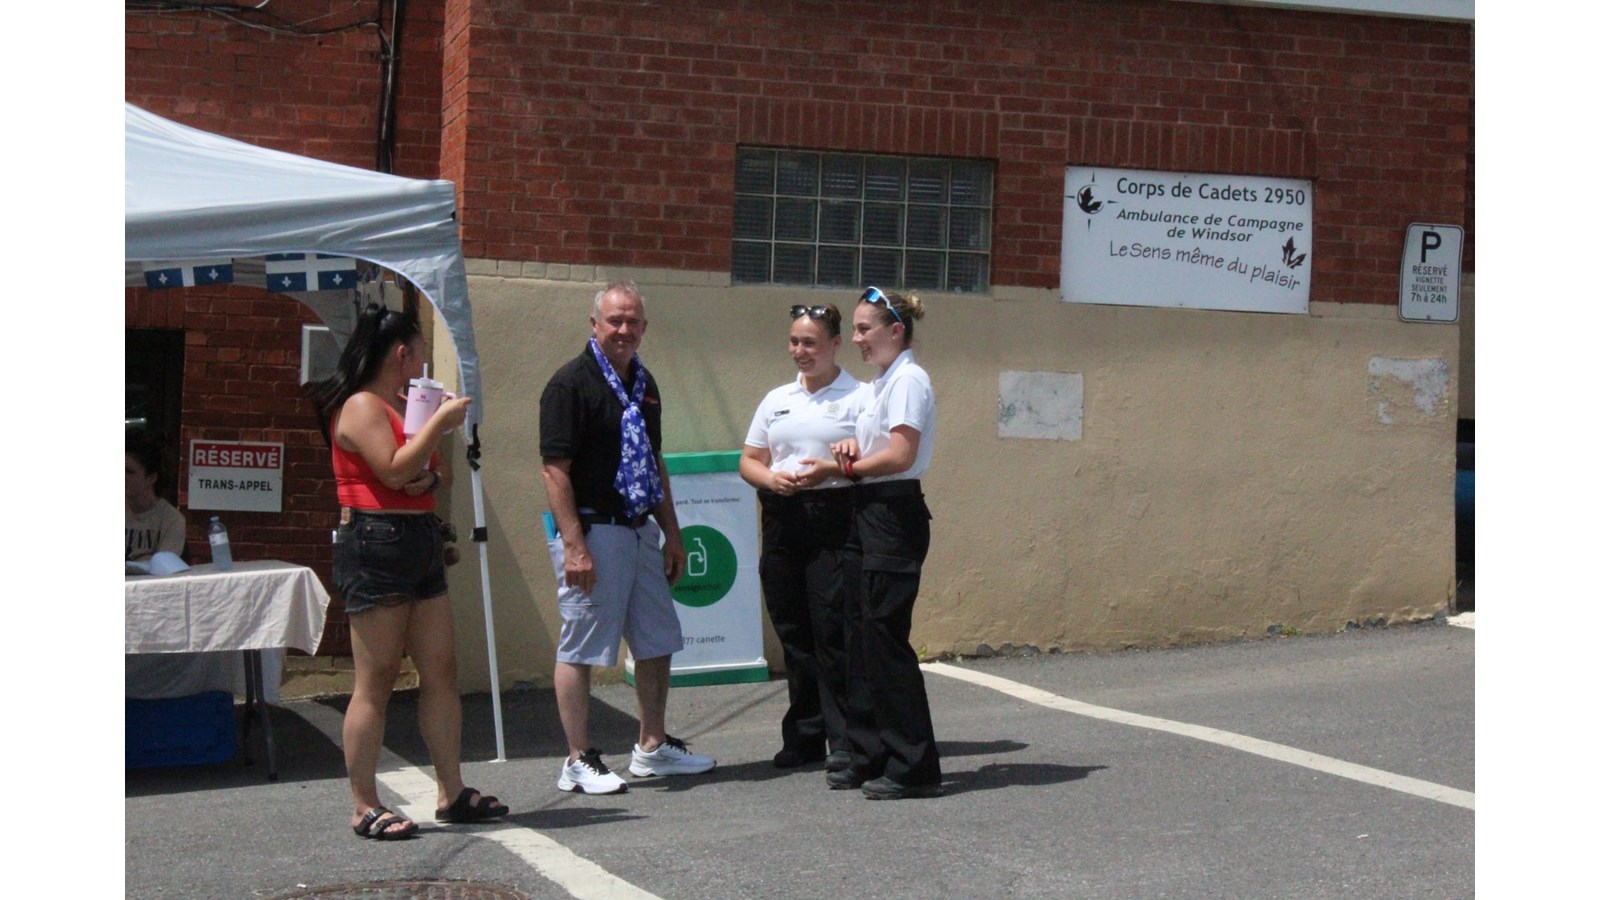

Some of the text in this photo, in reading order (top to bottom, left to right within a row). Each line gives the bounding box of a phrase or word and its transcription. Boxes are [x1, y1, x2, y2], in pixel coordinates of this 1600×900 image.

[1116, 177, 1306, 206] Corps de Cadets 2950
[1116, 208, 1304, 232] Ambulance de Campagne
[1166, 226, 1254, 242] de Windsor
[1421, 230, 1442, 263] P
[1175, 246, 1224, 270] même
[1227, 257, 1247, 275] du
[1250, 264, 1300, 290] plaisir
[1412, 264, 1448, 276] RÉSERVÉ
[1415, 276, 1444, 284] VIGNETTE
[1411, 284, 1448, 293] SEULEMENT
[1411, 292, 1421, 302] 7h
[1430, 293, 1447, 304] 24h
[194, 445, 278, 467] RÉSERVÉ
[198, 478, 273, 492] TRANS-APPEL
[696, 635, 726, 644] canette
